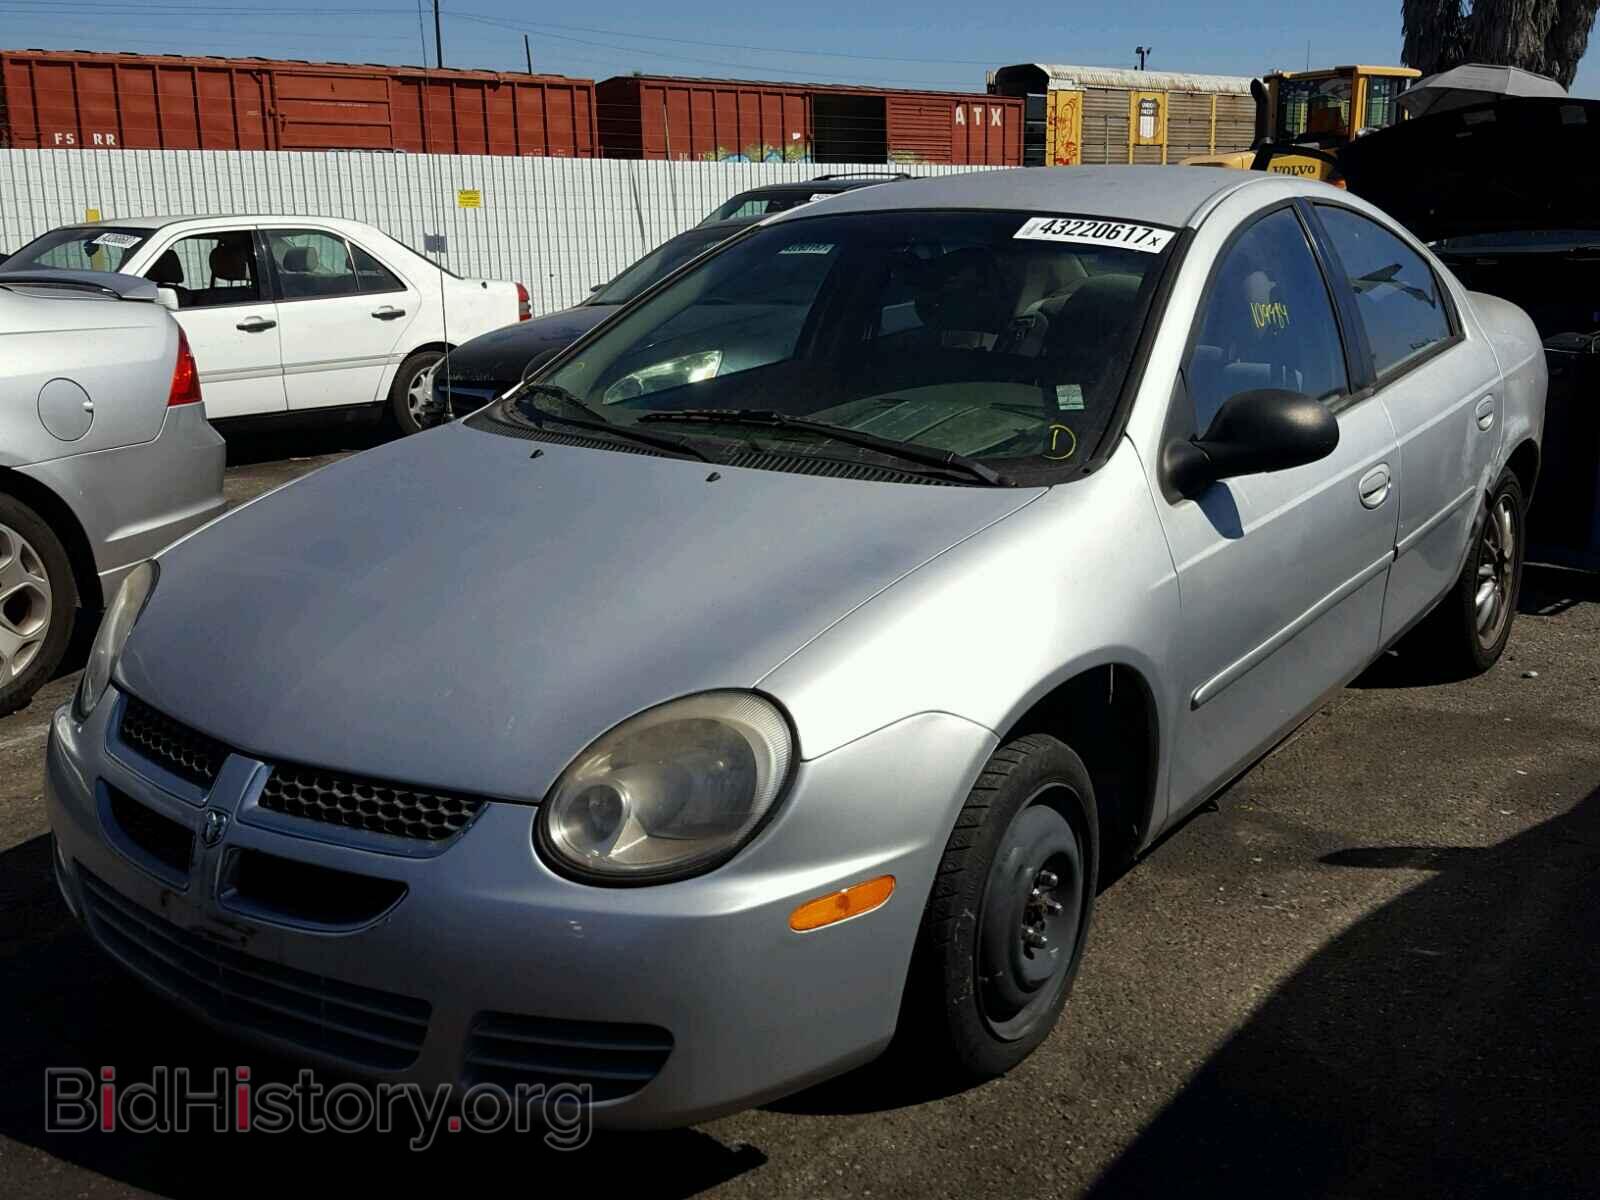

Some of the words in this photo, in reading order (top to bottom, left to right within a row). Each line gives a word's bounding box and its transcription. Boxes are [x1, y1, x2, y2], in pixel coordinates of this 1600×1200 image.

[955, 106, 1002, 127] ATX
[54, 132, 76, 145] FS
[92, 133, 117, 146] RR
[1272, 164, 1317, 177] VOLVO
